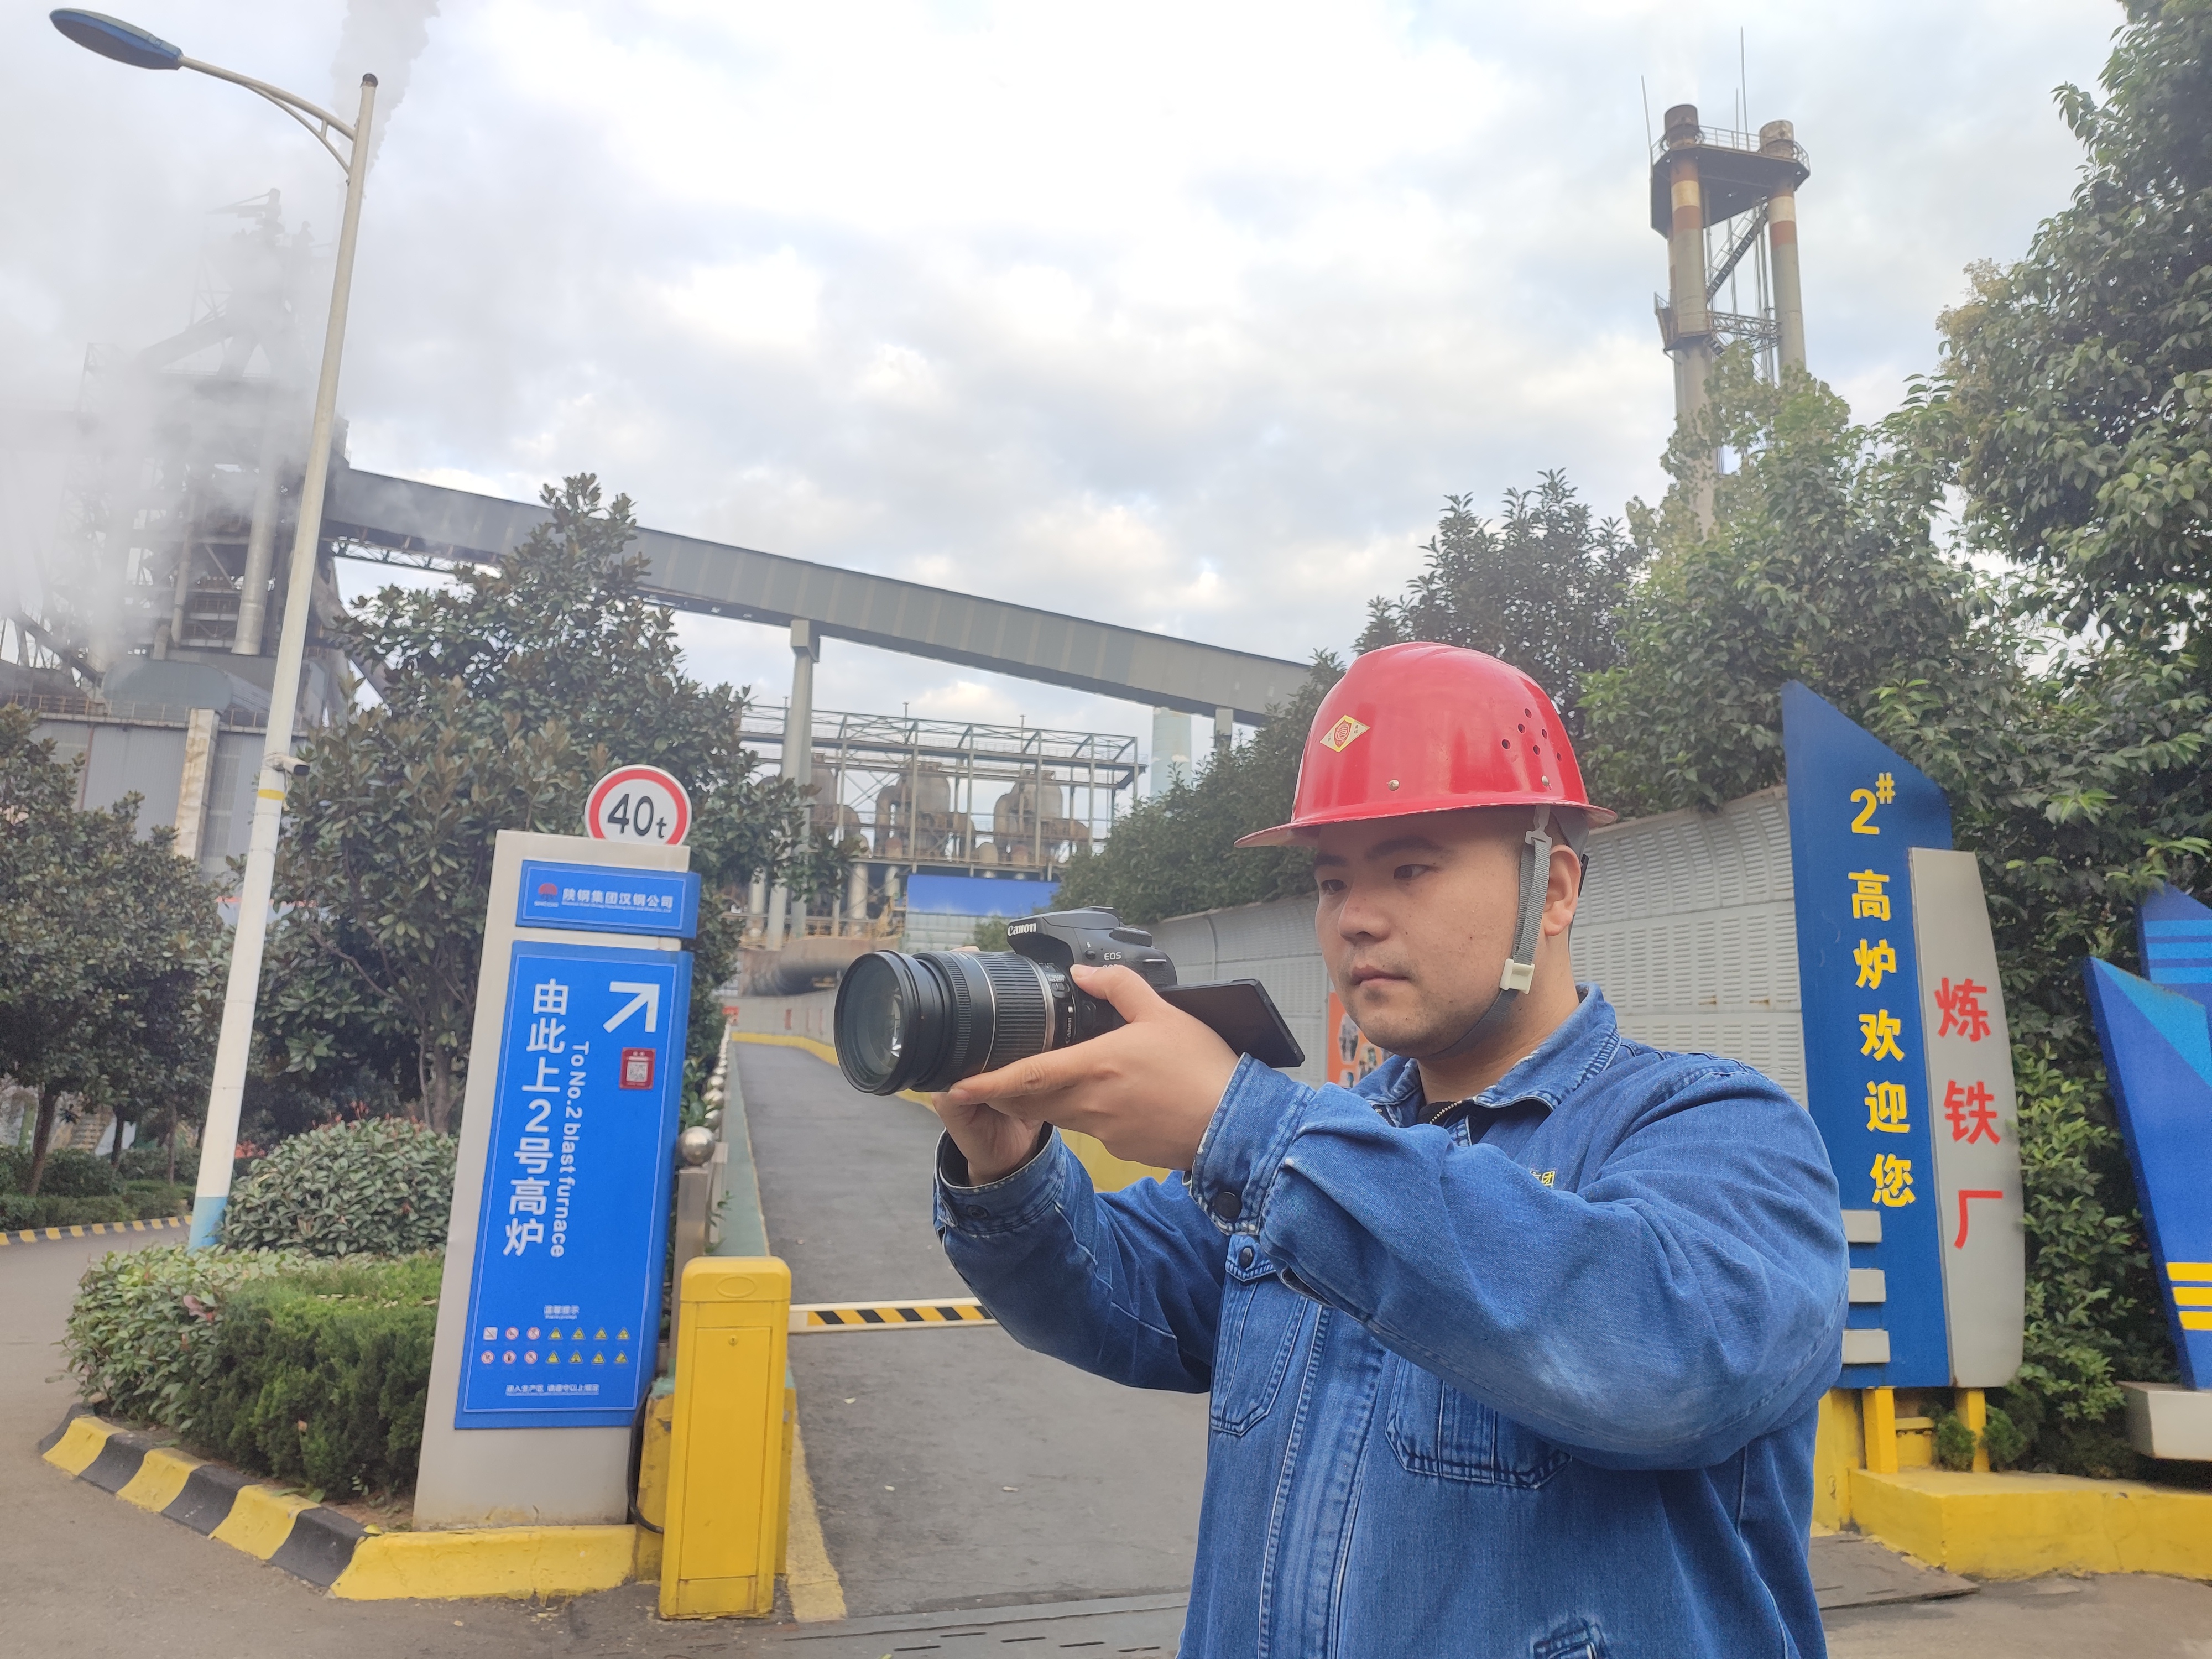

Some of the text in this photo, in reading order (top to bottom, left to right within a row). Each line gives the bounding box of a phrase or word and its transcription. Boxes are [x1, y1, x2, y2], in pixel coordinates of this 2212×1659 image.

[607, 793, 667, 838] 40t
[1007, 922, 1037, 936] Canon
[1104, 952, 1121, 961] EOS
[570, 1041, 590, 1067] To
[502, 978, 570, 1257] 由此上2号高炉
[1934, 977, 2004, 1250] 炼铁厂
[559, 1122, 581, 1174] blast
[550, 1176, 576, 1258] furnace
